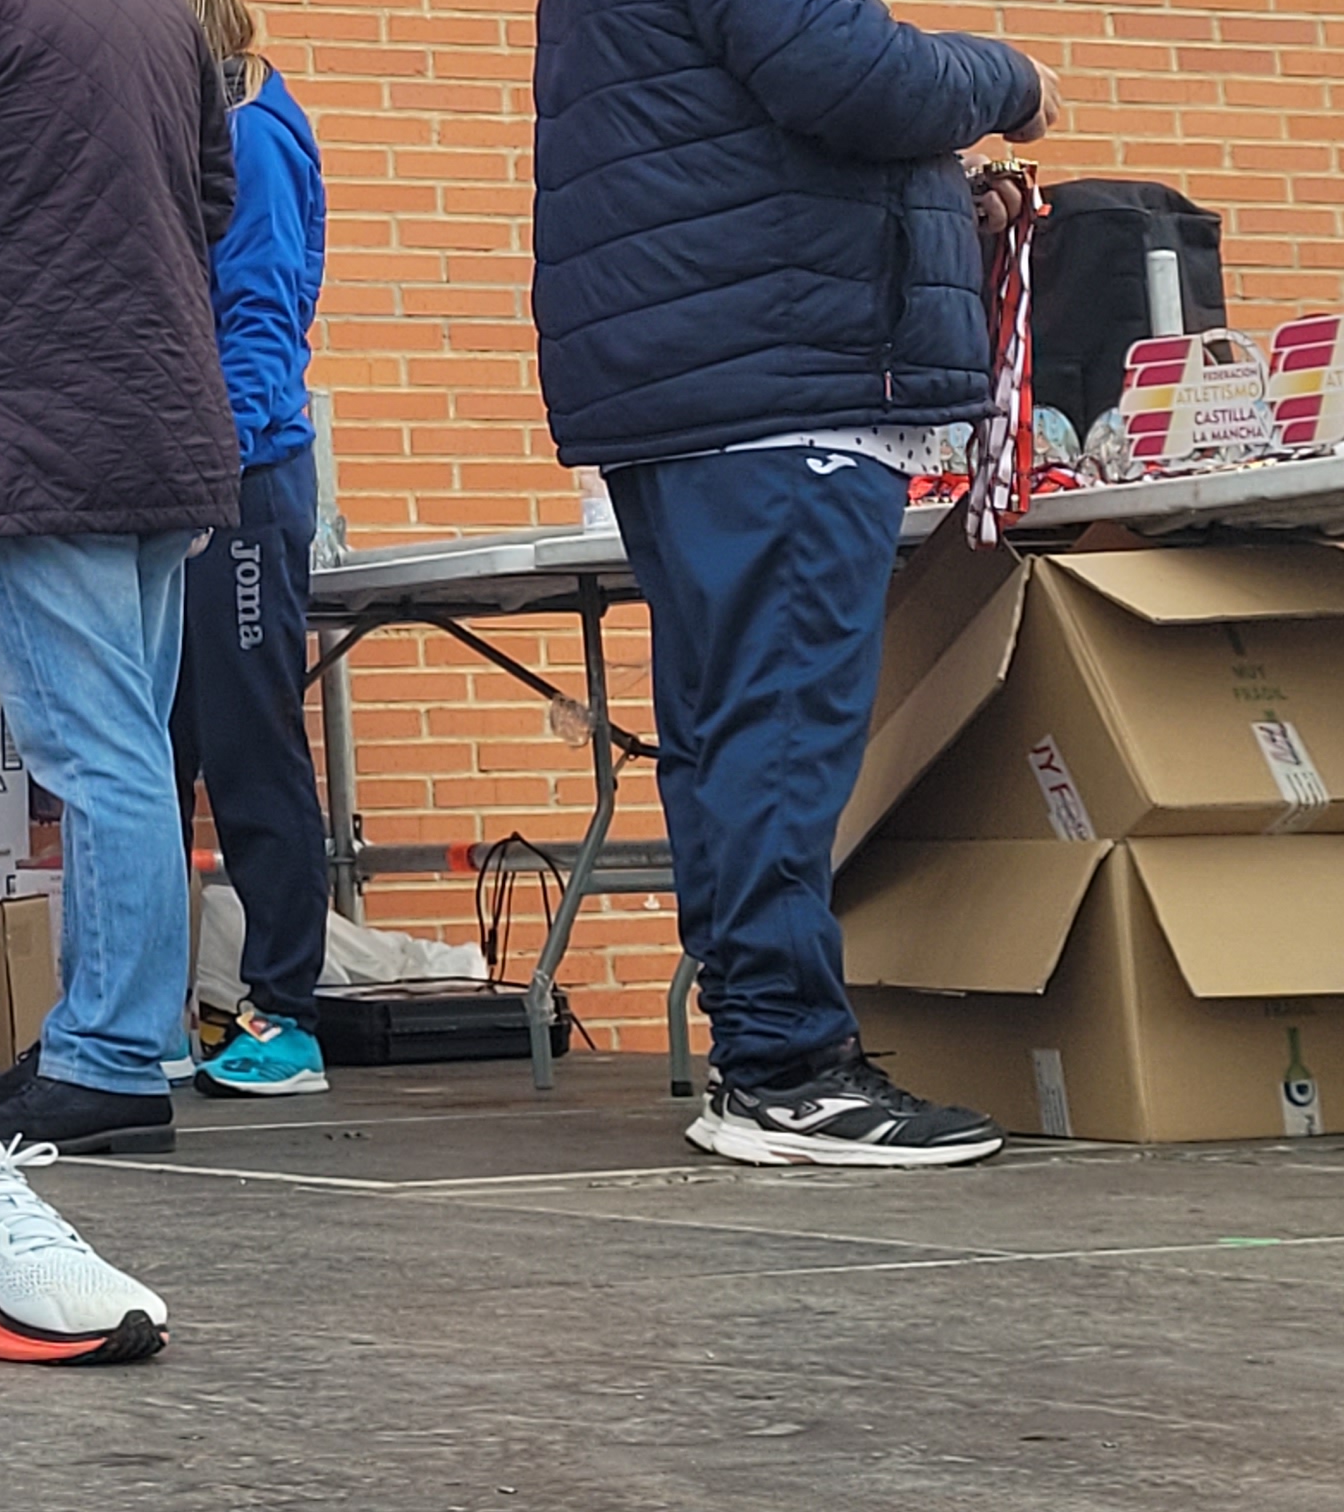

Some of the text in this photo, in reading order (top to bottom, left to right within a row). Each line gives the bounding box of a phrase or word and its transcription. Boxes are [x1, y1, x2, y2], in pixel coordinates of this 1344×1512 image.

[1326, 371, 1344, 387] AT
[1176, 382, 1260, 404] ATLETISMO
[1194, 407, 1256, 426] CASTILLA
[1193, 425, 1265, 444] LA MANCHA
